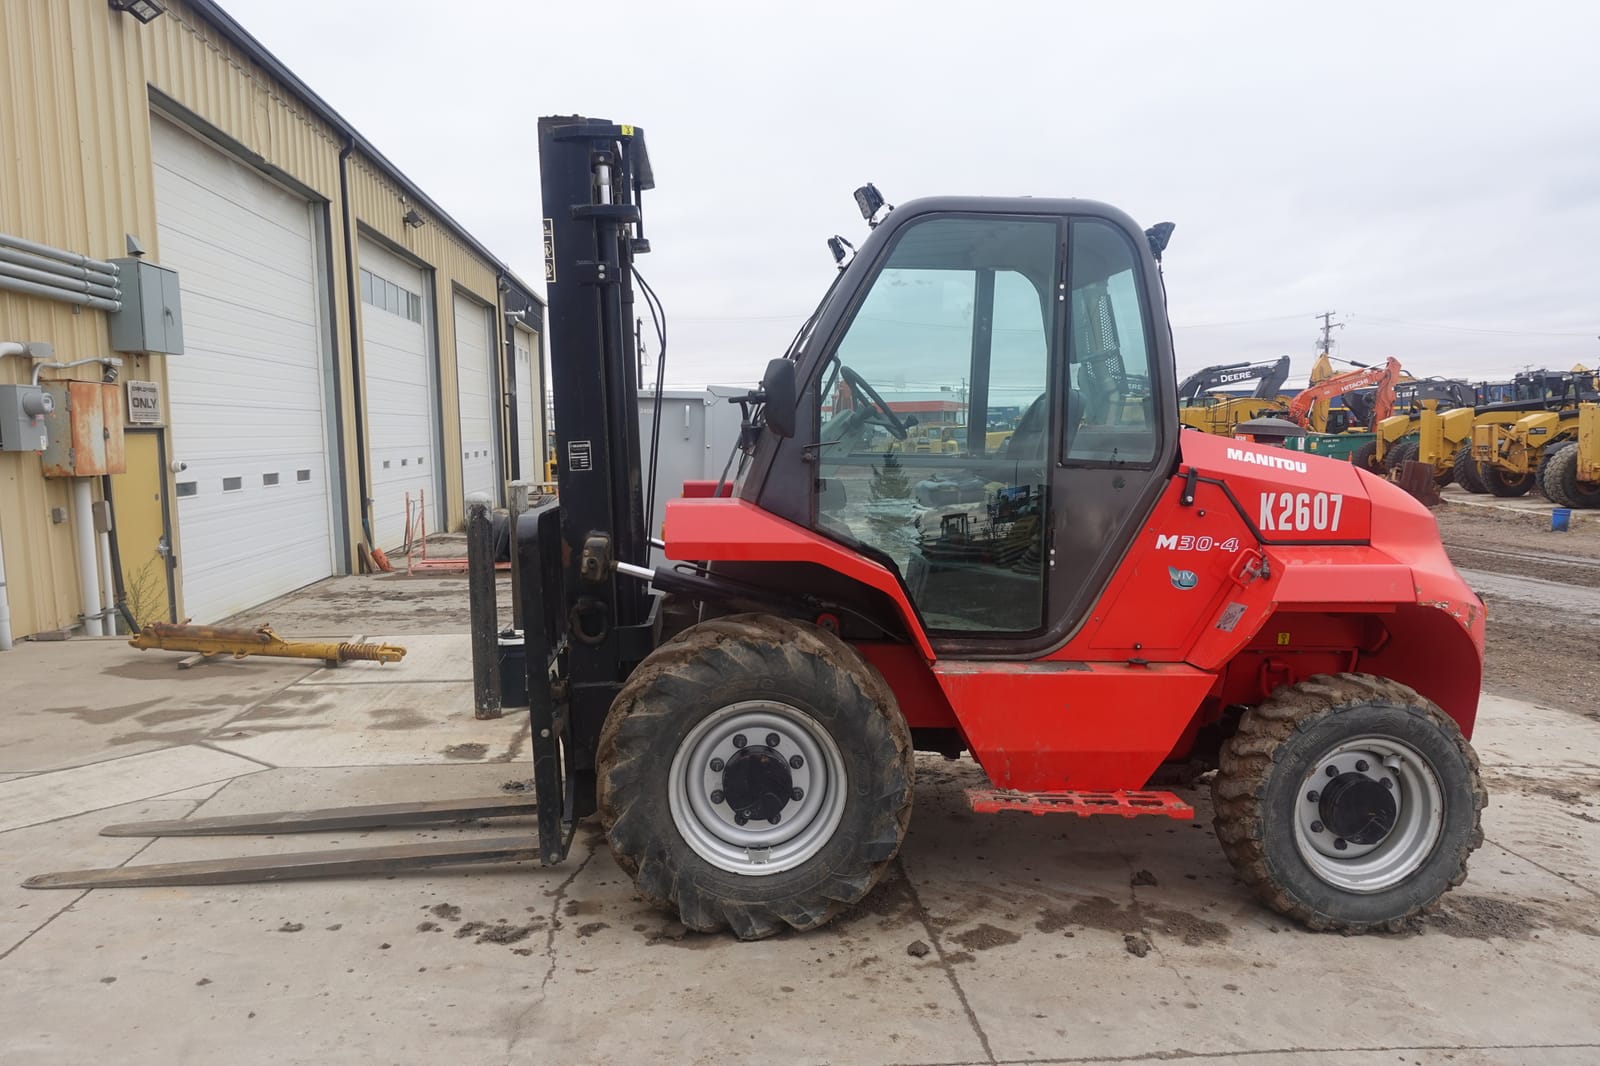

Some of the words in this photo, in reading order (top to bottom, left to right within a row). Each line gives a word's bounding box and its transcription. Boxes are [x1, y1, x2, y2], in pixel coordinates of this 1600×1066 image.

[1220, 371, 1252, 383] DEERE
[1341, 378, 1369, 392] HITACHI
[132, 397, 157, 409] ONLY
[1227, 447, 1307, 473] MANITOU
[1259, 492, 1343, 532] K2607
[1155, 534, 1239, 553] M30-4
